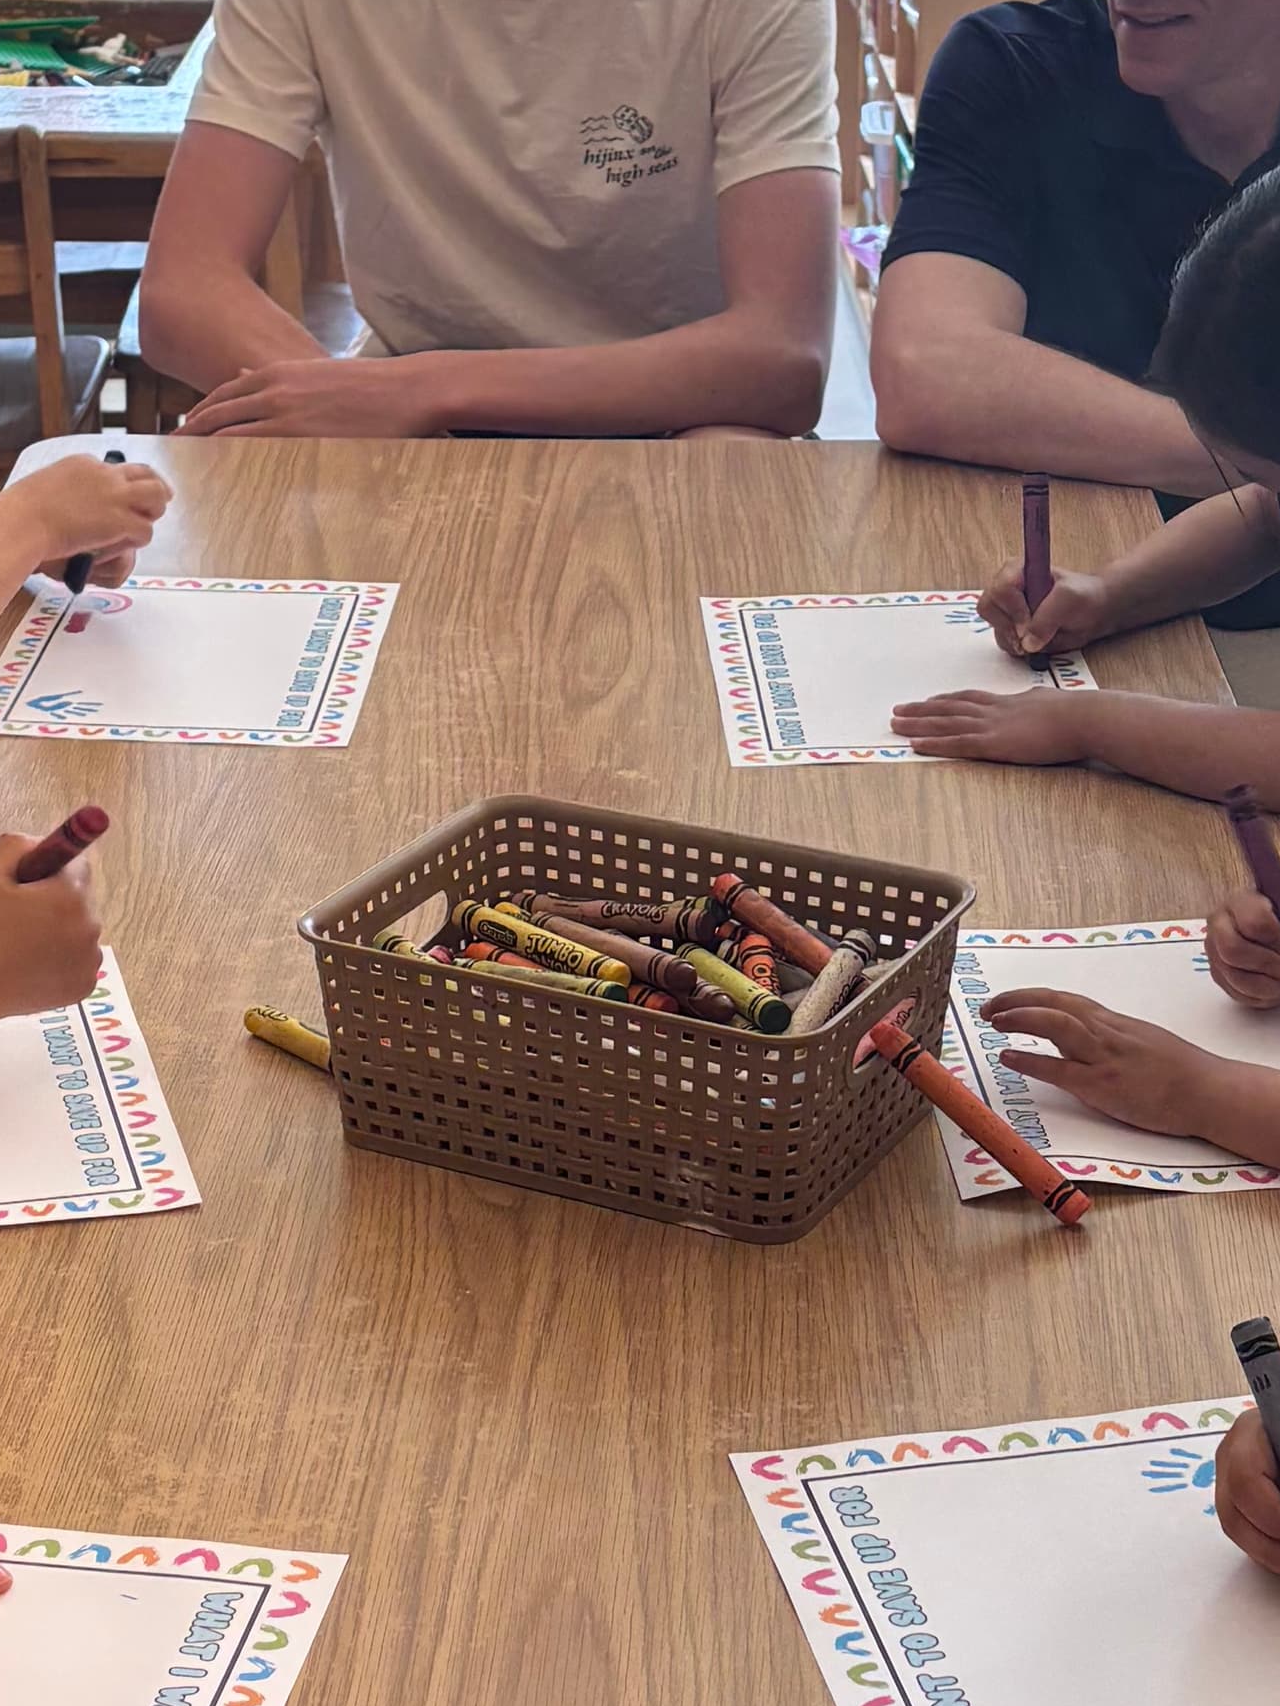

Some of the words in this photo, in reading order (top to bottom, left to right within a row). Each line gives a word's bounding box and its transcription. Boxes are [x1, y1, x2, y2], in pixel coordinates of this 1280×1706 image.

[606, 164, 644, 187] high
[648, 156, 679, 177] seas
[600, 901, 667, 924] CRAYONS
[524, 933, 584, 970] JUMBO
[958, 978, 991, 994] UP
[43, 1025, 84, 1067] WANT
[979, 1032, 1012, 1050] TO
[56, 1069, 90, 1090] TO
[63, 1093, 103, 1130] SAVE
[74, 1132, 110, 1154] UP
[81, 1157, 120, 1187] FOR
[829, 1485, 880, 1528] FOR
[850, 1533, 896, 1564] UP
[868, 1568, 928, 1628] SAVE
[178, 1592, 244, 1662] WHAT
[900, 1632, 946, 1668] TO
[168, 1666, 208, 1678] I
